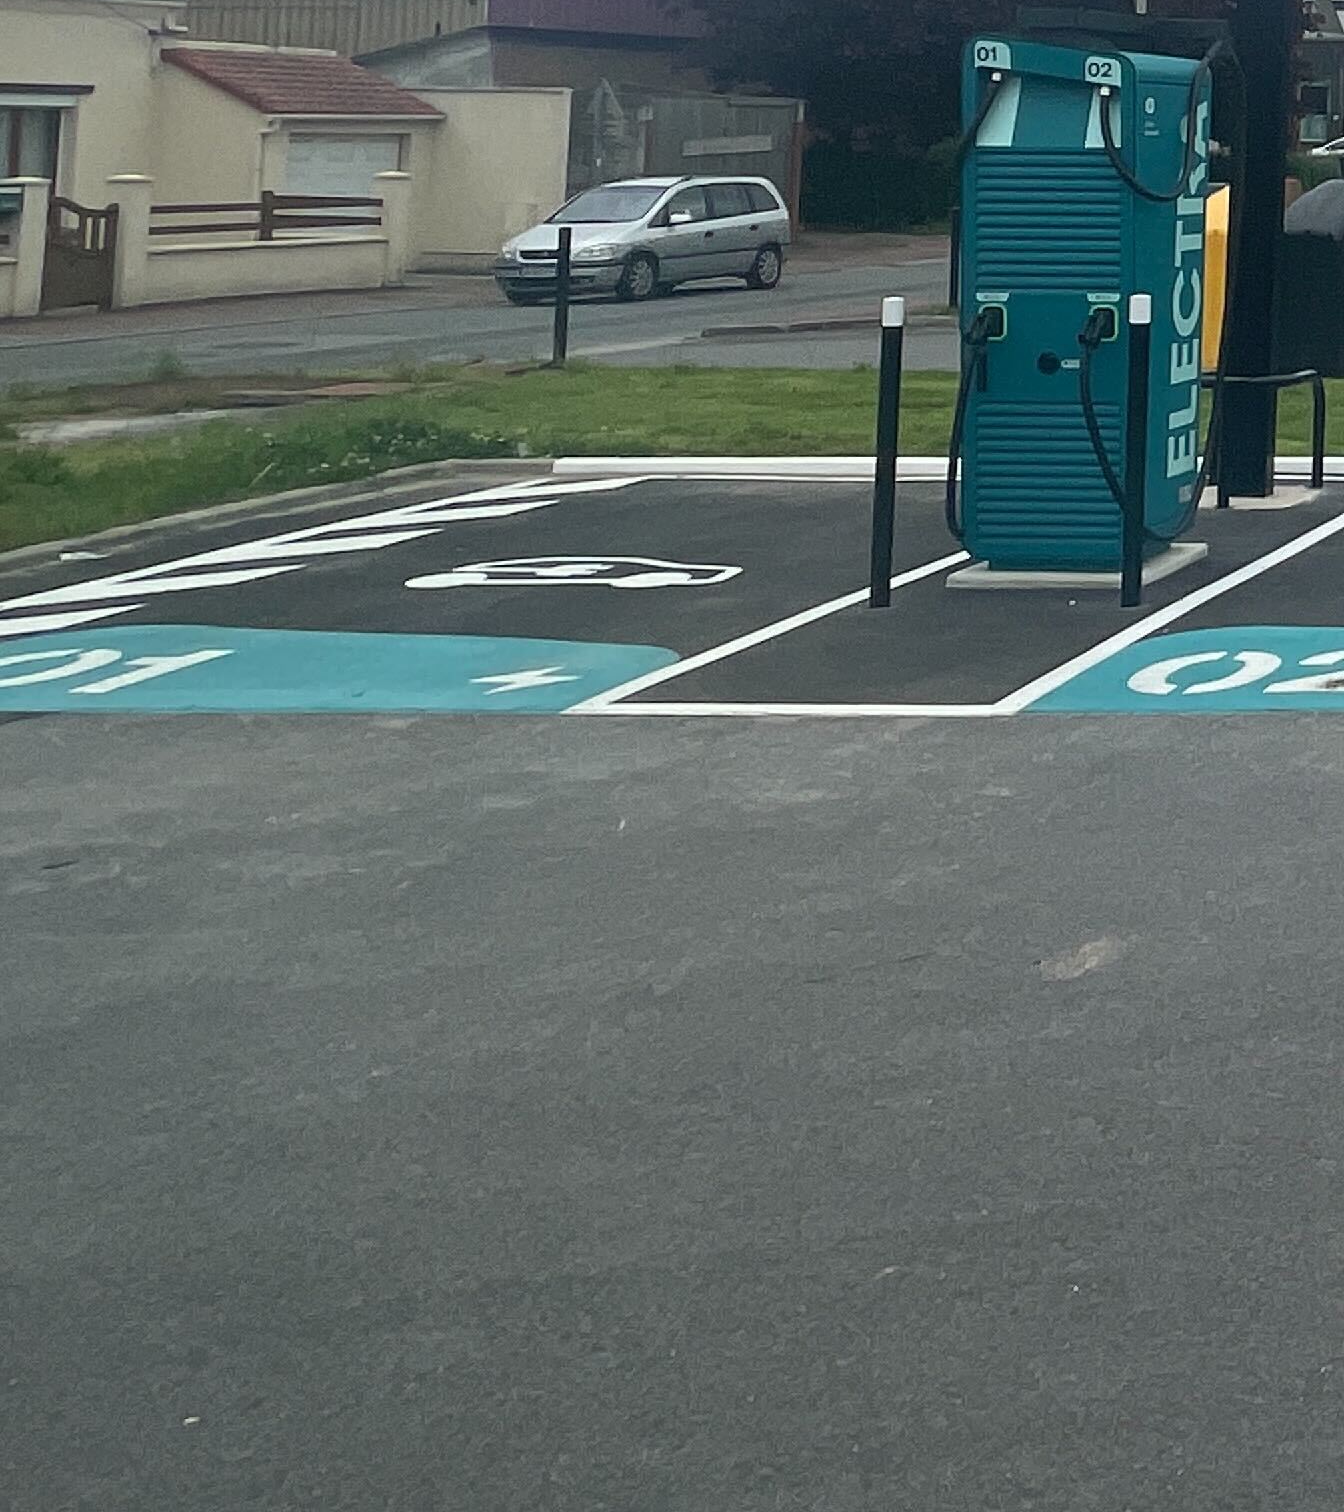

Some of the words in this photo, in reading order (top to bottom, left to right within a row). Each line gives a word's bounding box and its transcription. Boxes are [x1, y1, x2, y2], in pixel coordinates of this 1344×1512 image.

[976, 46, 998, 62] 01
[1087, 62, 1113, 78] 02
[0, 648, 236, 694] 01
